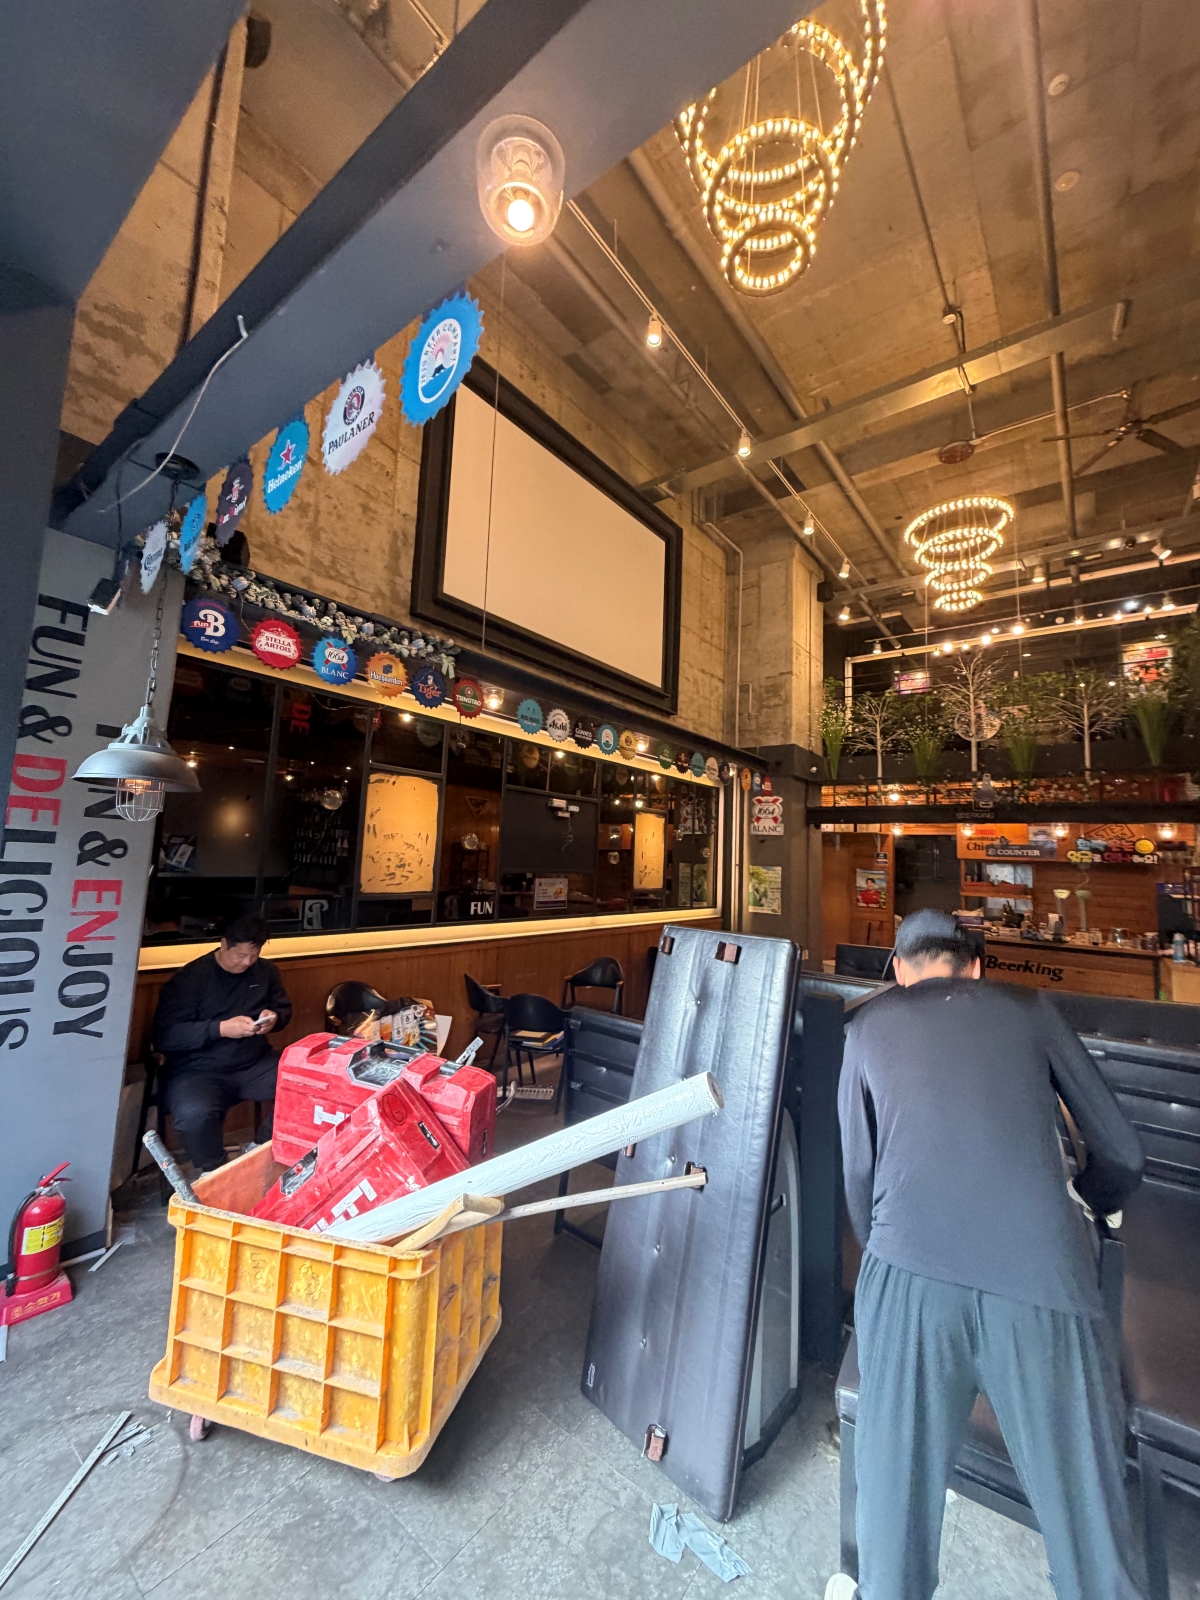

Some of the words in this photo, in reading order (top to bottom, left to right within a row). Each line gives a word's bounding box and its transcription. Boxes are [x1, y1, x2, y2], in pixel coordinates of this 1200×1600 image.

[327, 411, 375, 455] PAULANER
[267, 460, 302, 494] Heineken
[26, 593, 90, 698] FUN
[264, 641, 292, 653] ARTOIS
[265, 635, 292, 648] STELLA
[321, 666, 349, 680] BLANC
[370, 671, 403, 686] Hoegaarden
[418, 683, 442, 699] Tiger
[456, 694, 482, 706] TSINGTAO
[18, 704, 72, 744] &
[549, 720, 568, 732] Asahi
[757, 807, 776, 815] 1664
[752, 825, 781, 833] BLANC
[77, 831, 128, 866] &
[470, 901, 494, 915] FUN
[53, 879, 123, 1038] ENJOY
